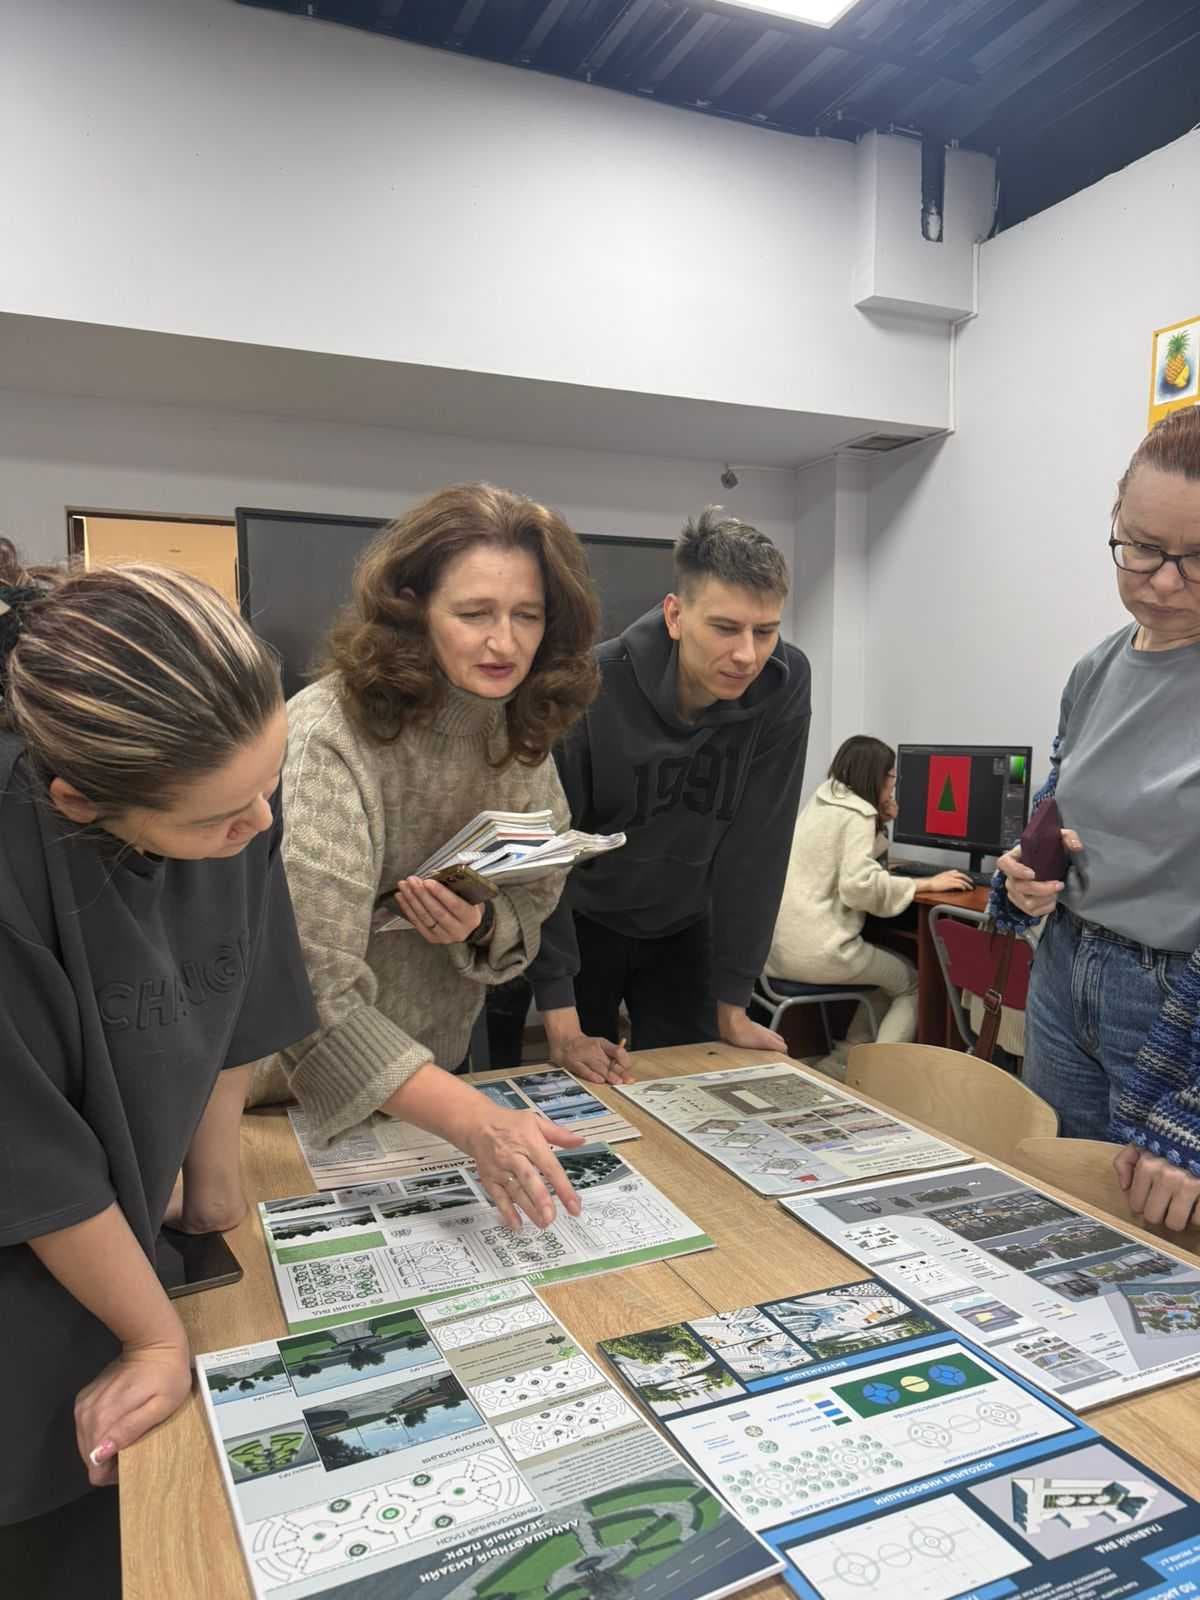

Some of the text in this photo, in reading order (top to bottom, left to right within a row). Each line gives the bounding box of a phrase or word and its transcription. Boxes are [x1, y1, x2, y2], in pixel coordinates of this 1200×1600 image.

[419, 1519, 580, 1584] ЛАНДШАФТНЫЙ ДИЗАЙН
[1094, 1522, 1163, 1554] ГЛАВНЫЙ ВИД
